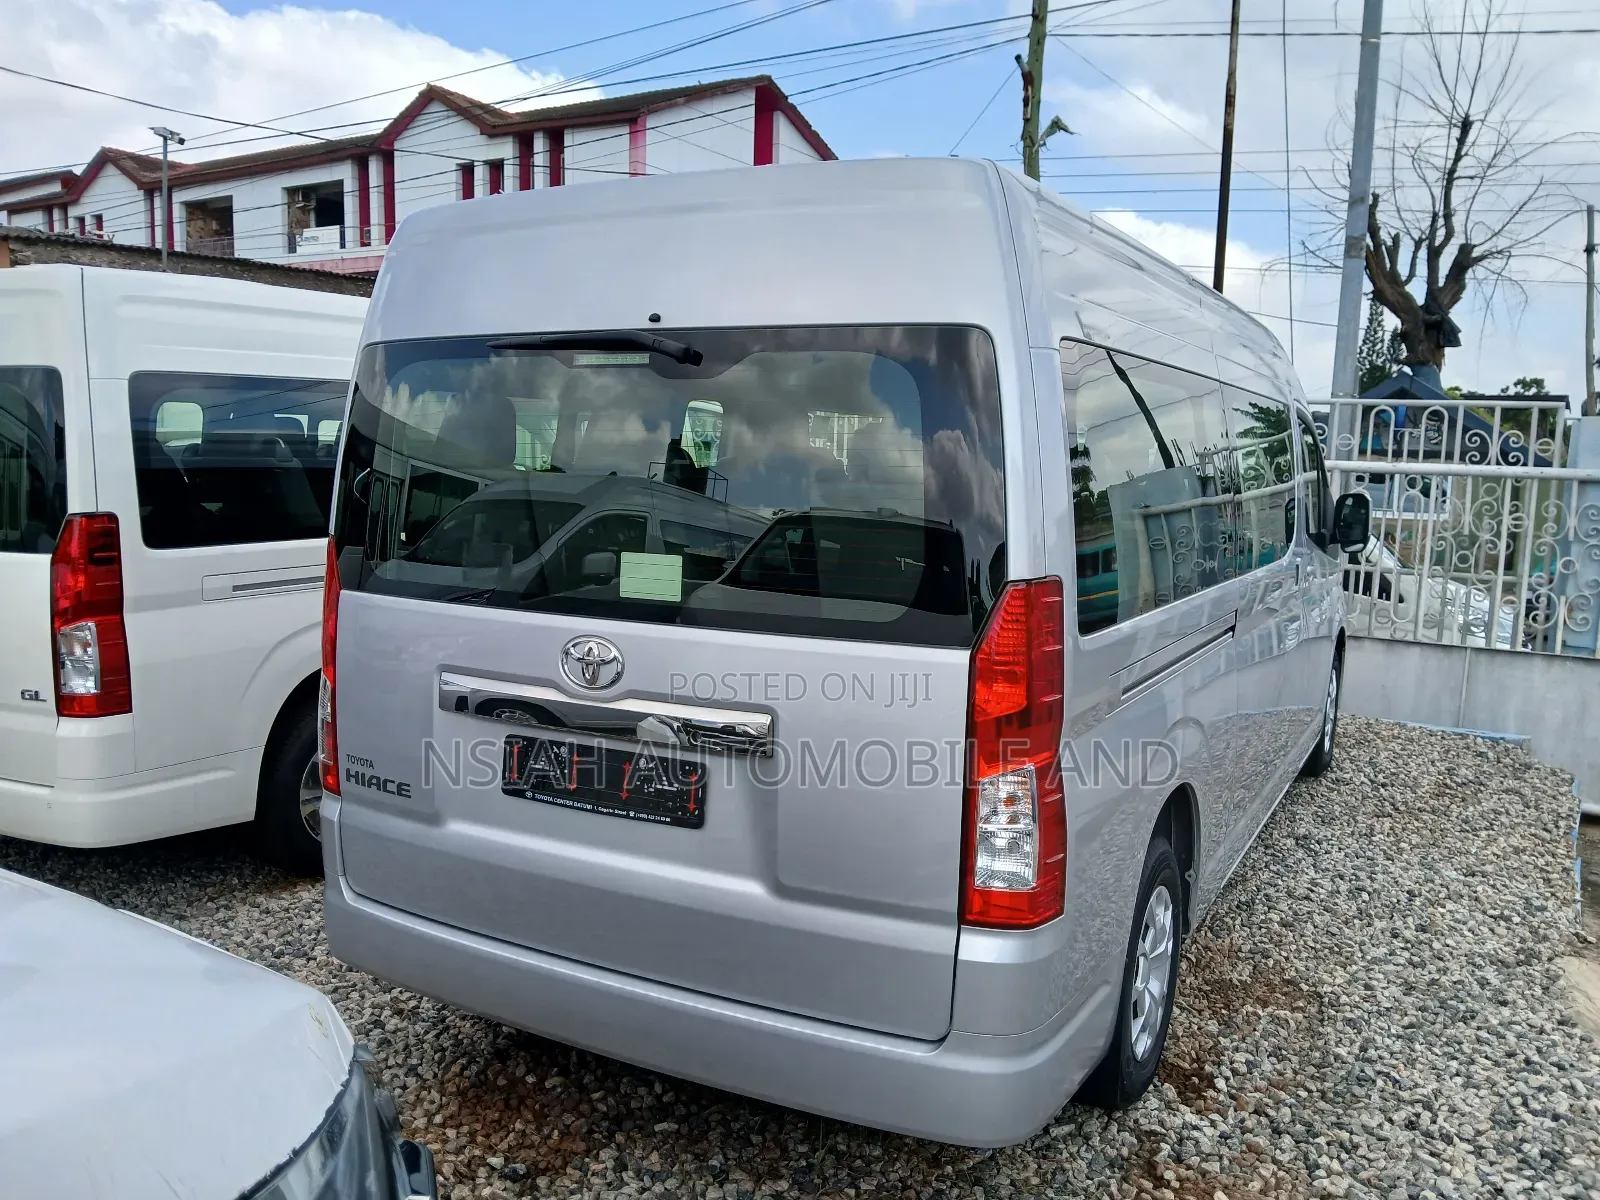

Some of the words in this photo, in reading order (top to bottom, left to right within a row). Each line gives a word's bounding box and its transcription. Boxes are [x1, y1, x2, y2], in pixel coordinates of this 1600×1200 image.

[20, 688, 48, 703] GL
[345, 753, 375, 770] TOYOTA
[345, 767, 412, 799] HIACE
[534, 793, 554, 802] TOYOTA
[553, 797, 574, 806] CENTER
